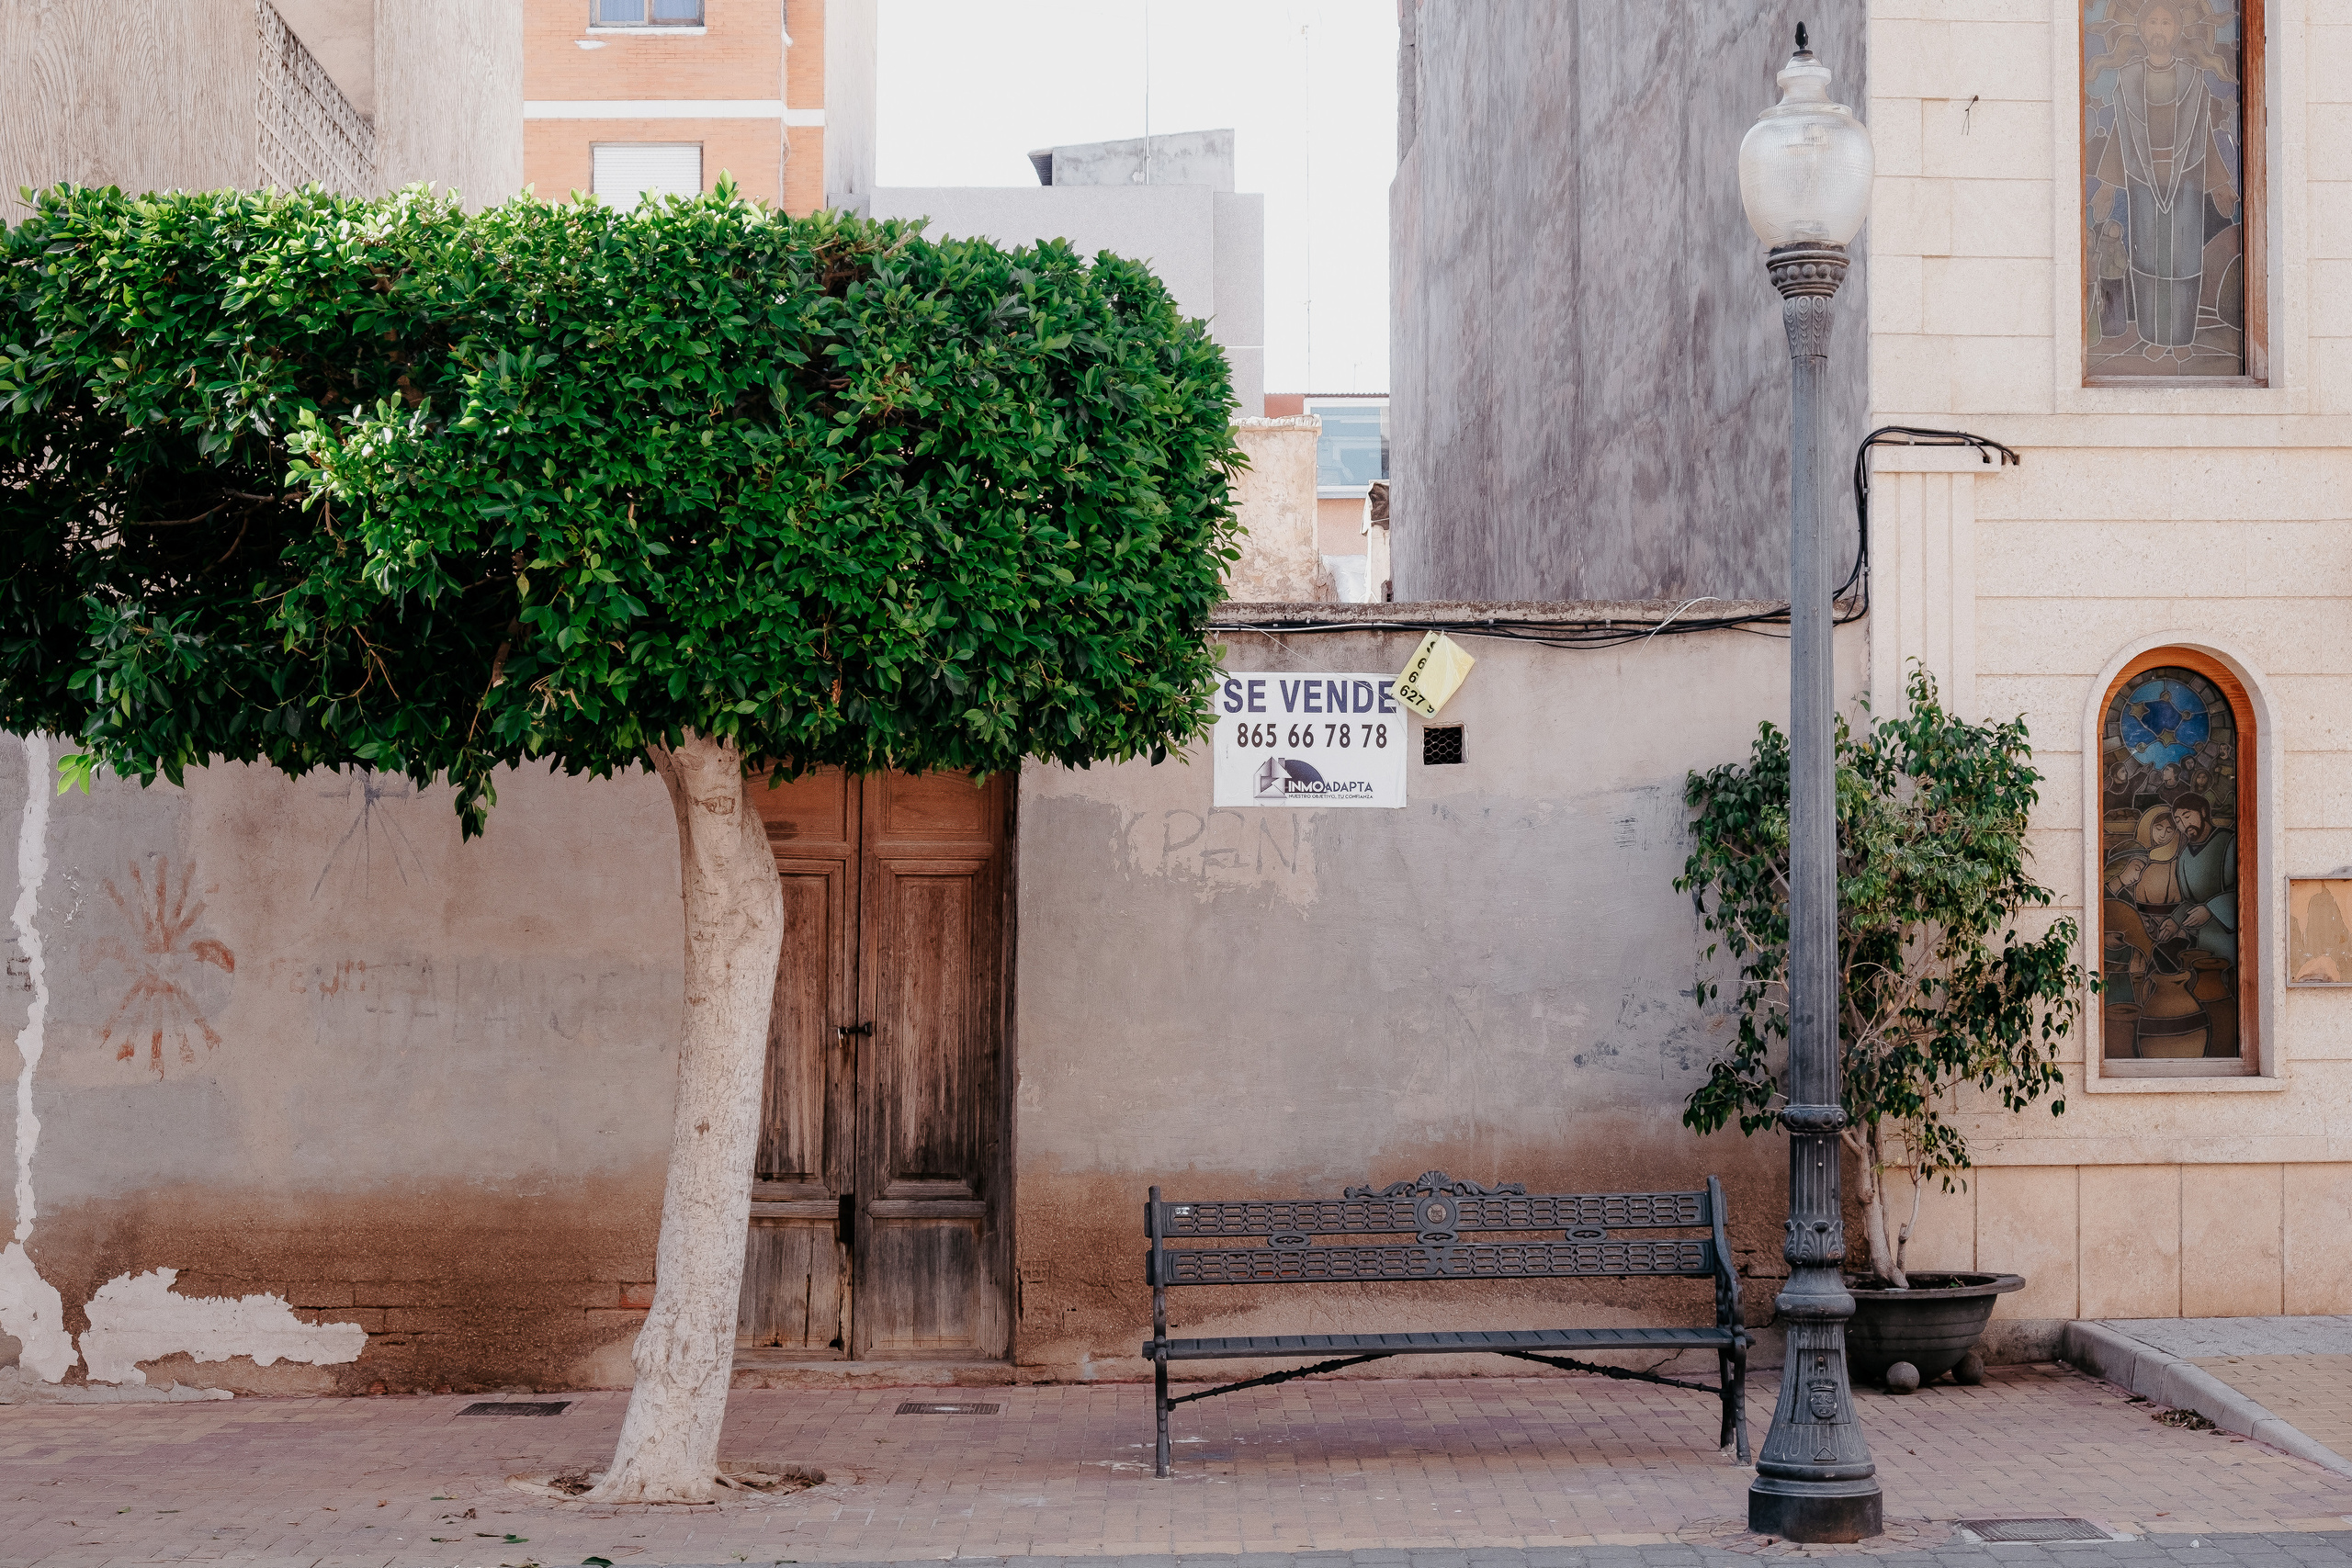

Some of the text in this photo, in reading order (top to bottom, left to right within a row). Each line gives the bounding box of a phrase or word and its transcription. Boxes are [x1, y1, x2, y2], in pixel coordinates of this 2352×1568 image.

[1223, 679, 1397, 715] SE VENDE
[1237, 722, 1388, 749] 865 66 78 78
[1288, 780, 1374, 793] INMOADAPTA
